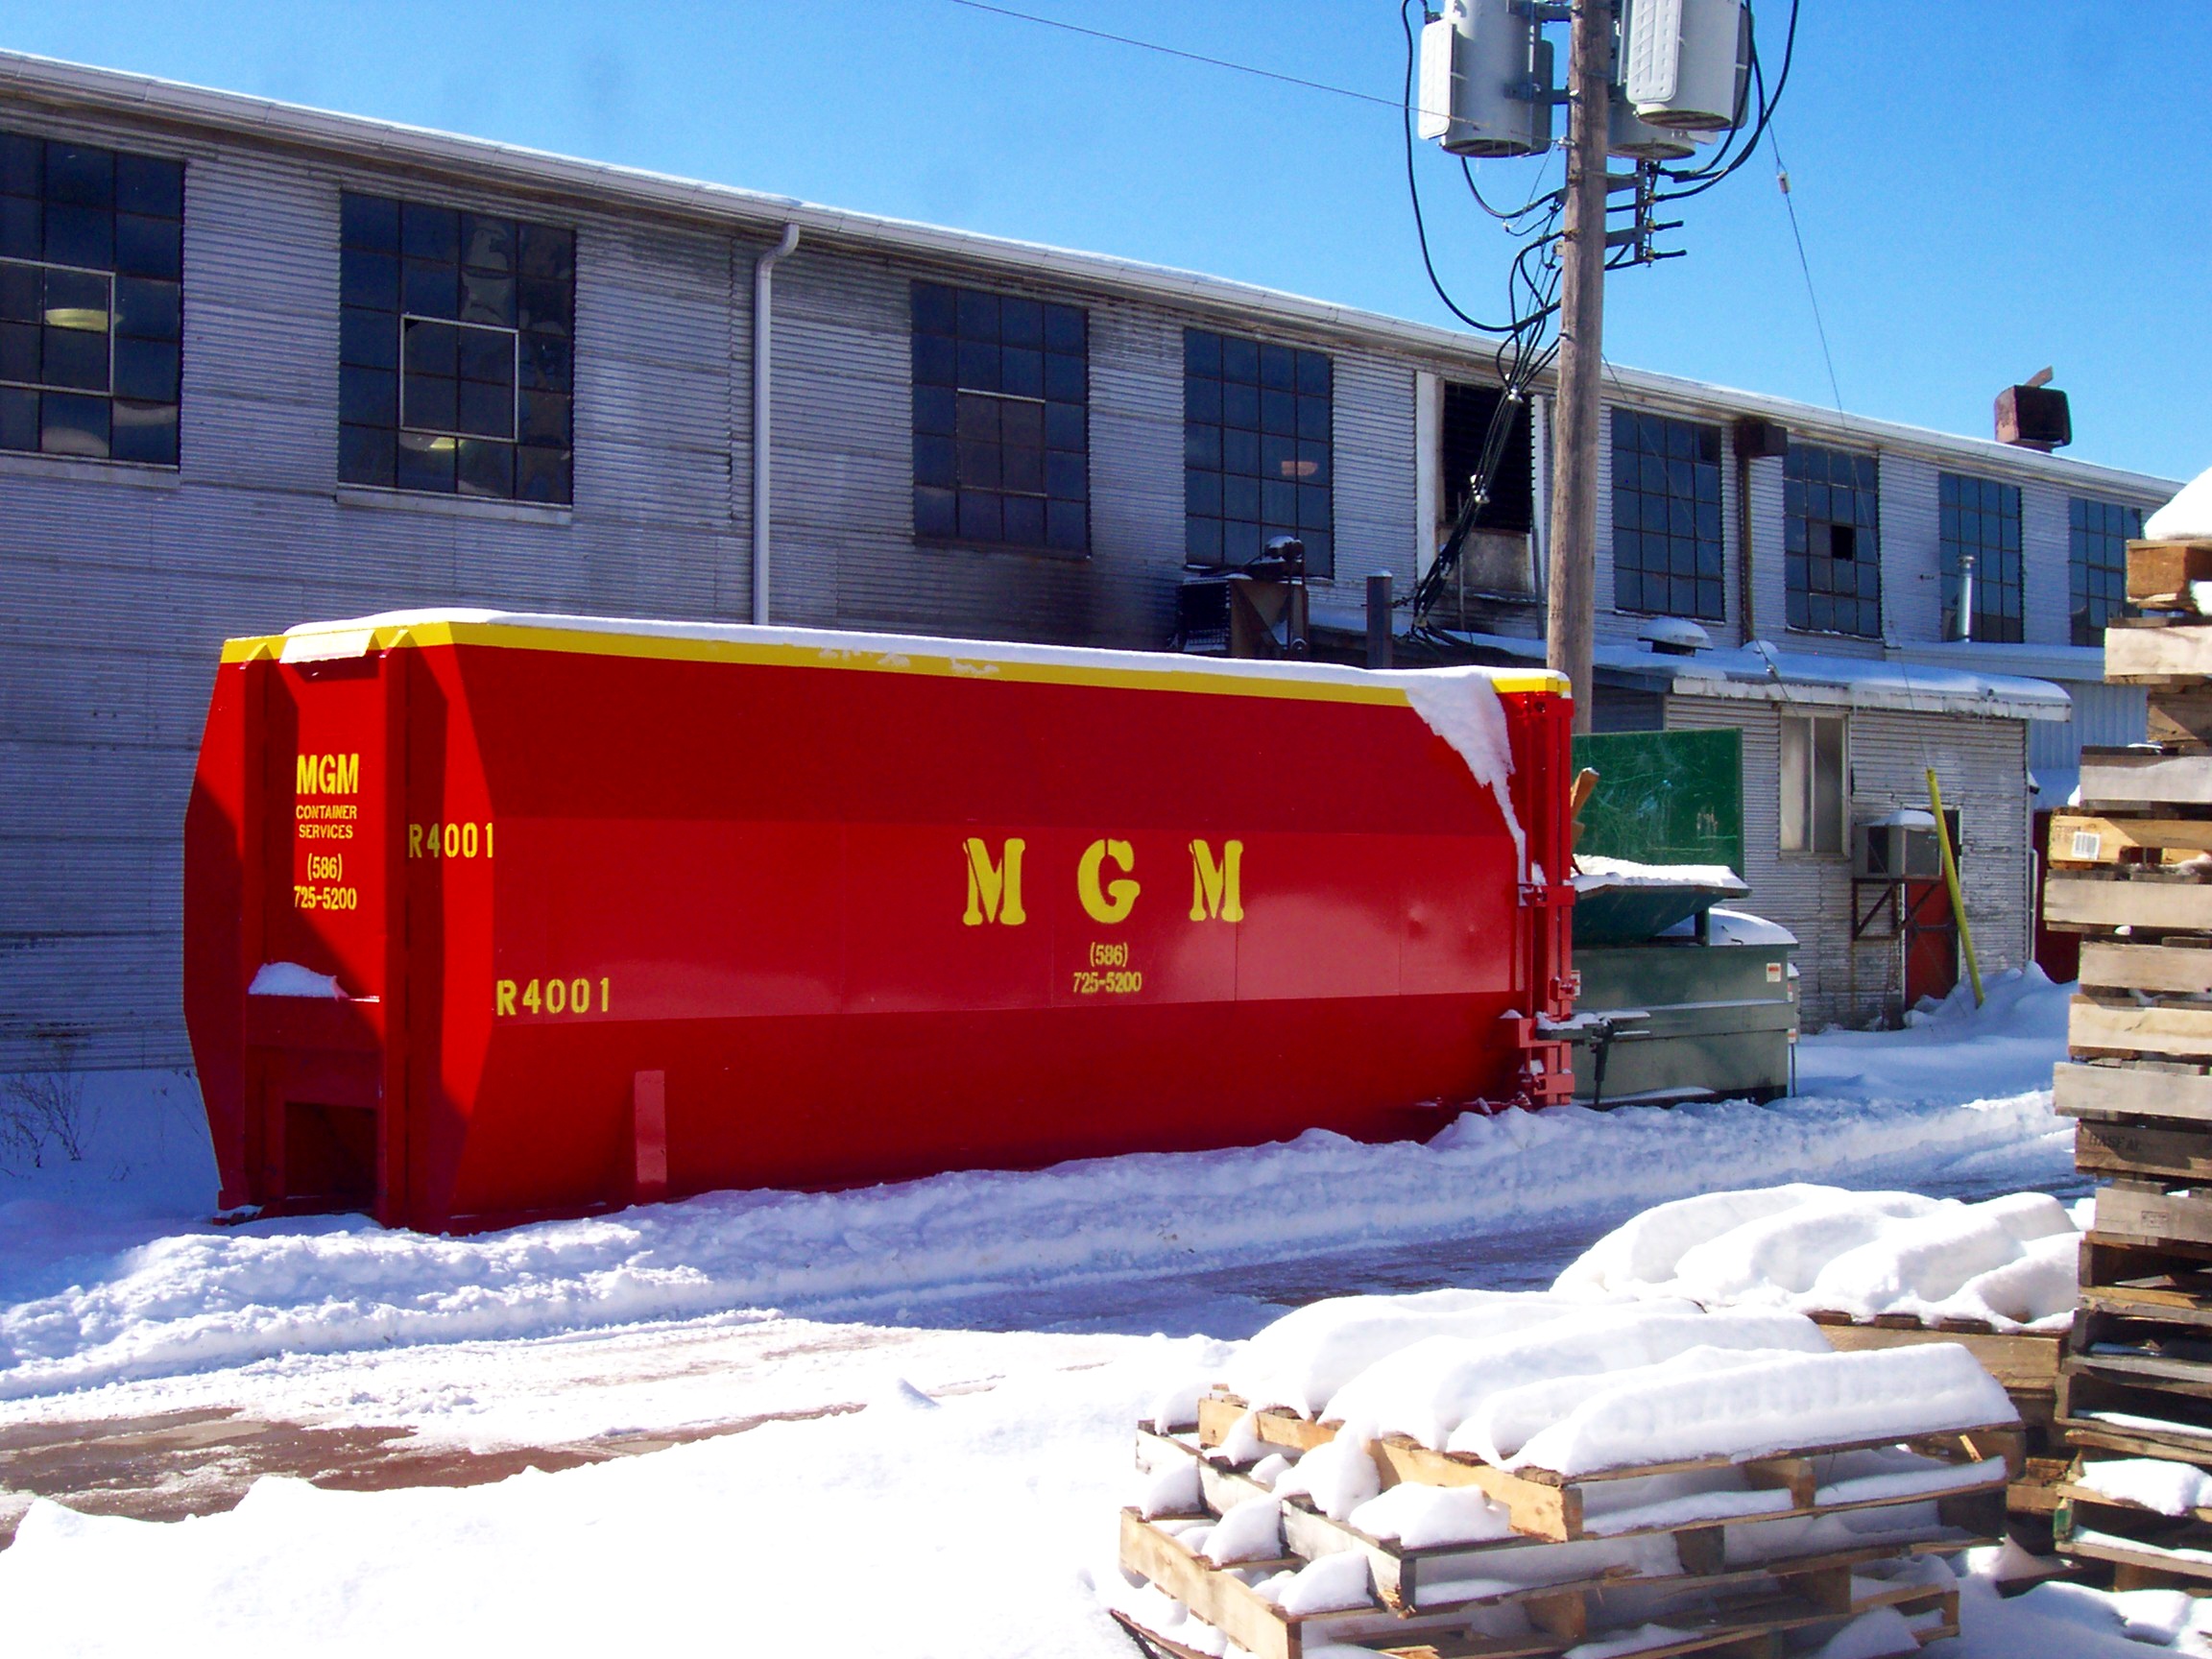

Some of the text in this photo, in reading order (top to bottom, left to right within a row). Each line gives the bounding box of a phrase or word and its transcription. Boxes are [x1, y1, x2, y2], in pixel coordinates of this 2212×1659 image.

[296, 753, 360, 795] MGM
[295, 805, 358, 821] CONTAINER
[299, 824, 353, 840] SERVICES
[407, 822, 494, 859] R4001
[306, 852, 344, 882] (586)
[293, 884, 358, 911] 725-5200
[1089, 941, 1130, 968] (586)
[495, 976, 611, 1017] R4001
[1072, 971, 1143, 995] 725-5200
